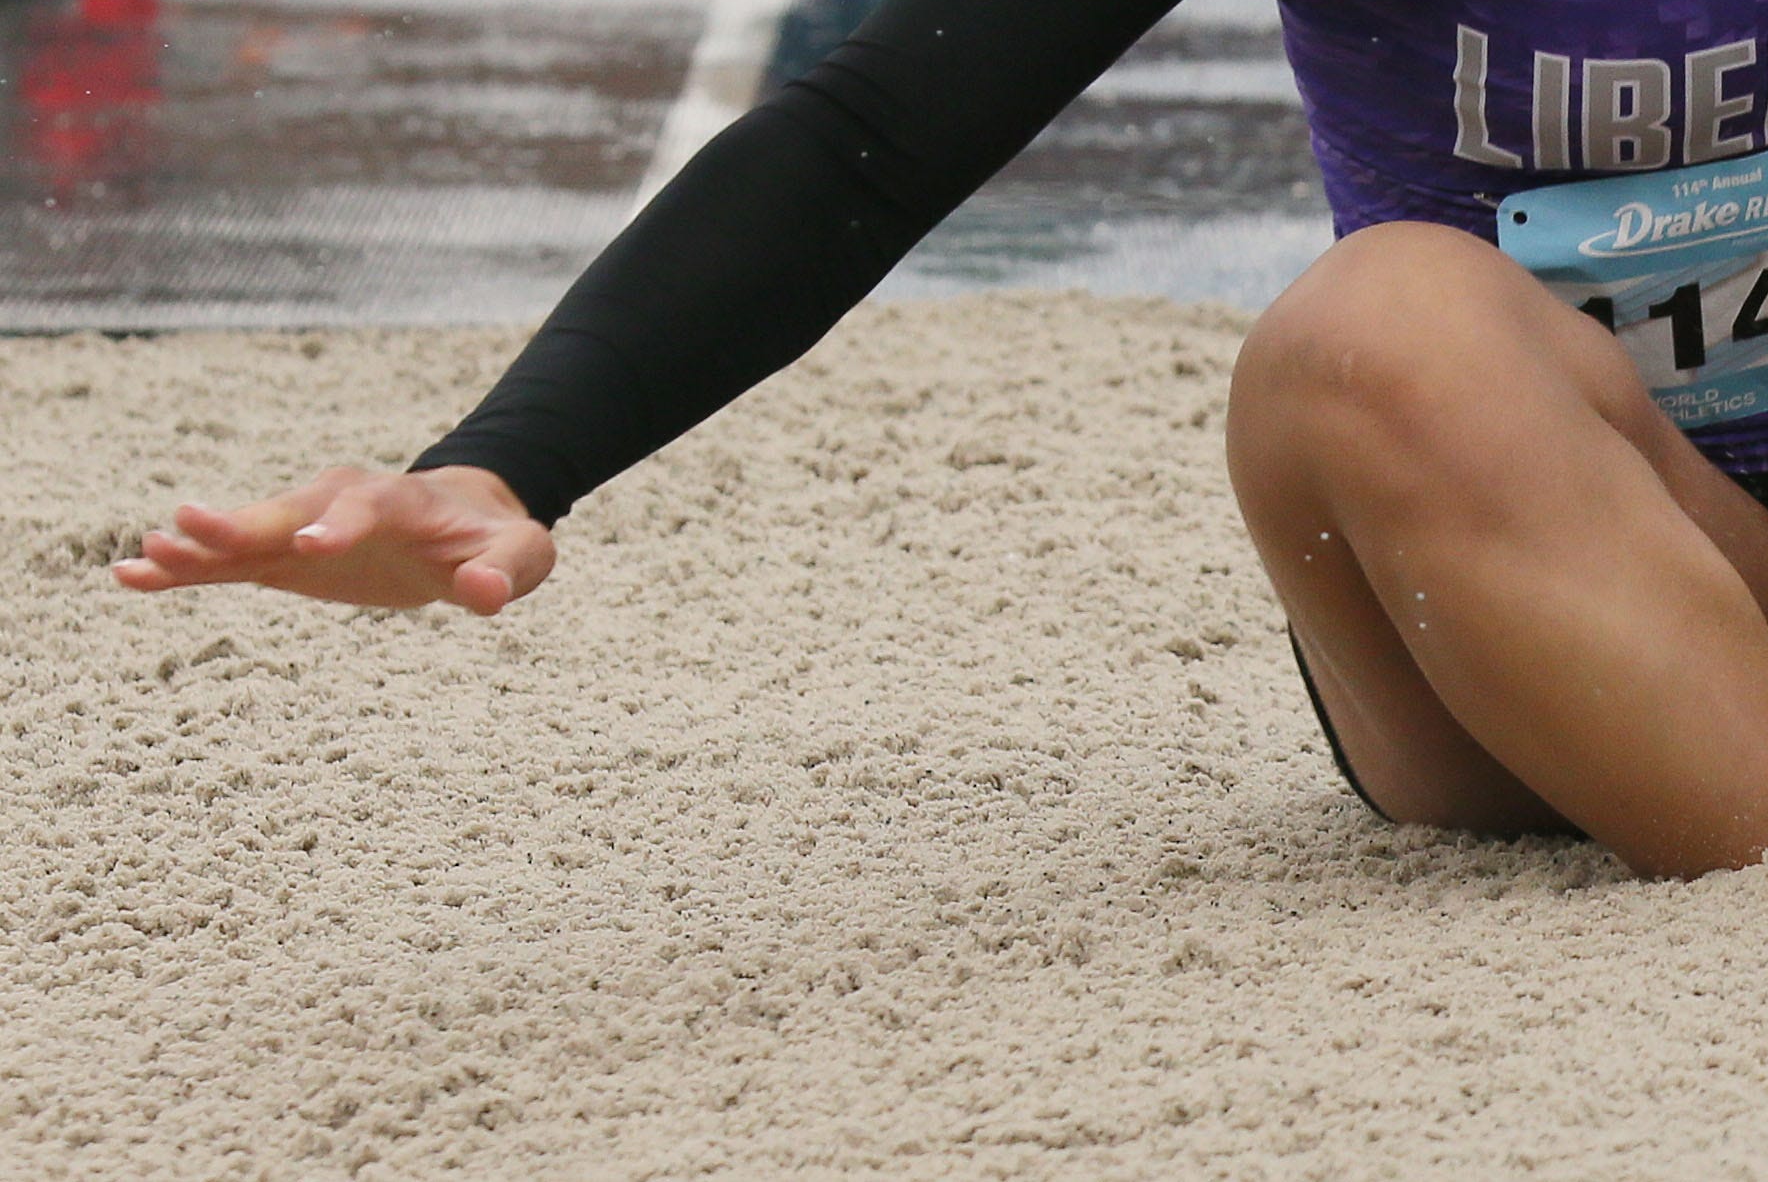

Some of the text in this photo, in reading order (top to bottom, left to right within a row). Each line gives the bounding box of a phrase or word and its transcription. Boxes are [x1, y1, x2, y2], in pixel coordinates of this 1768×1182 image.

[1712, 167, 1763, 190] Annual
[1612, 200, 1741, 249] Drake
[1656, 388, 1719, 408] ORLD
